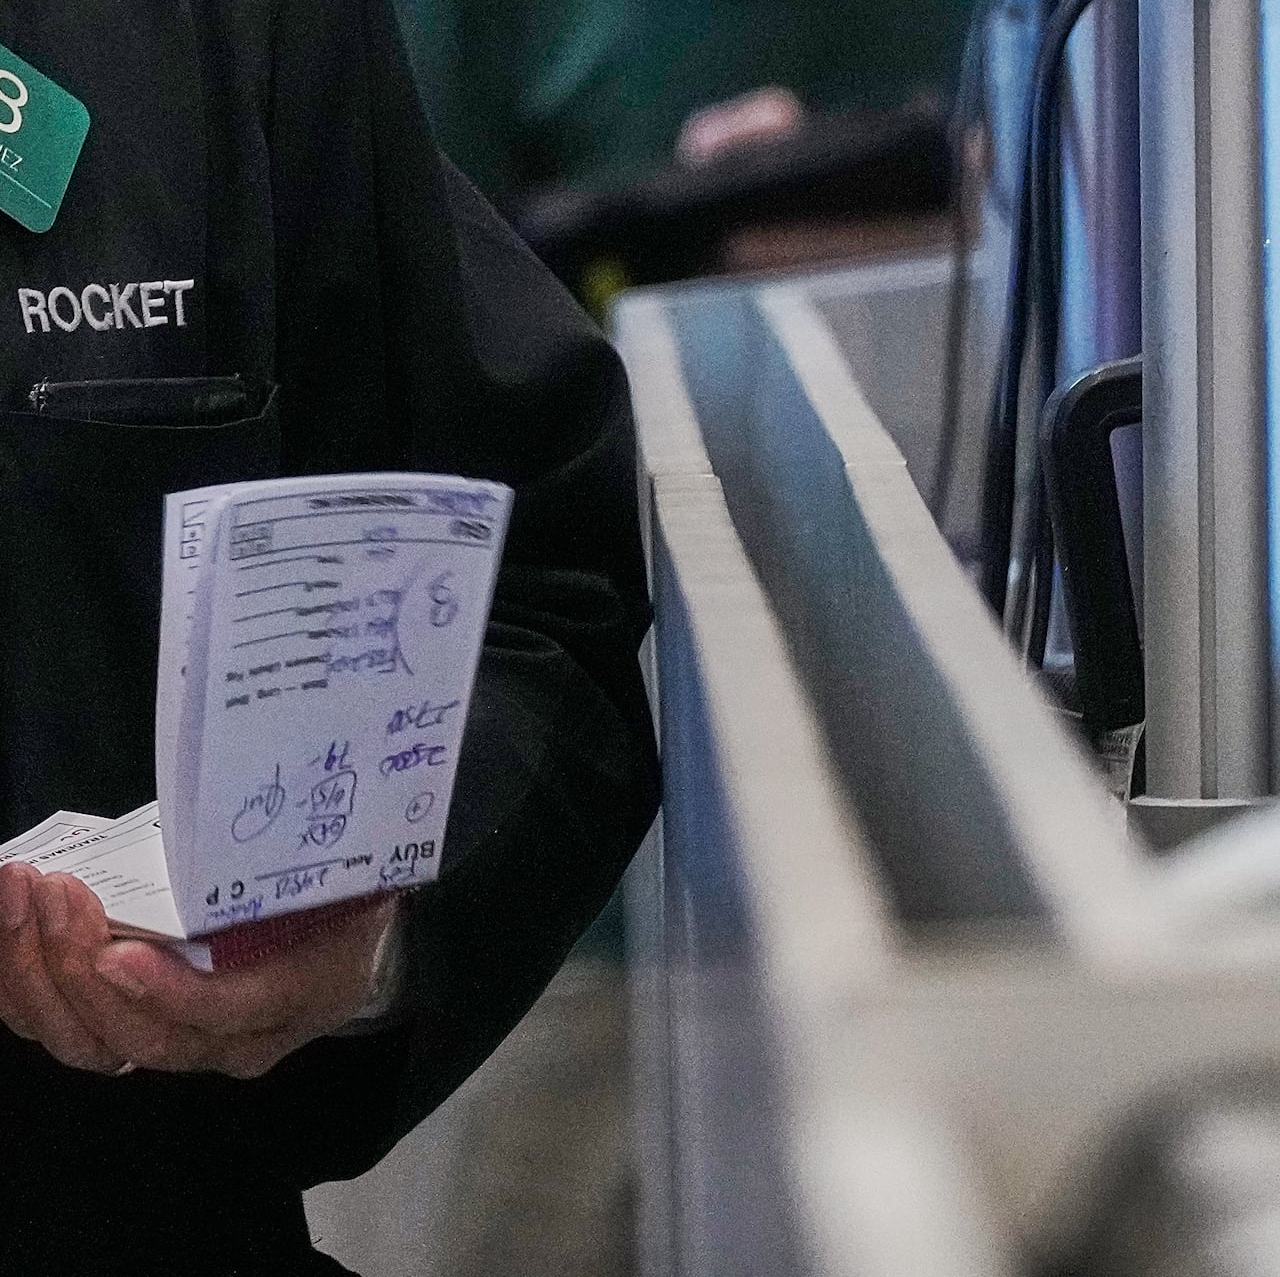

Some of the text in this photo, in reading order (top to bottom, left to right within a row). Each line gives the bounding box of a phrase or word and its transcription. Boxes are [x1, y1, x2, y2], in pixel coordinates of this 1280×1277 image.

[17, 278, 195, 334] ROCKET
[390, 839, 435, 863] BUY
[206, 885, 219, 906] P
